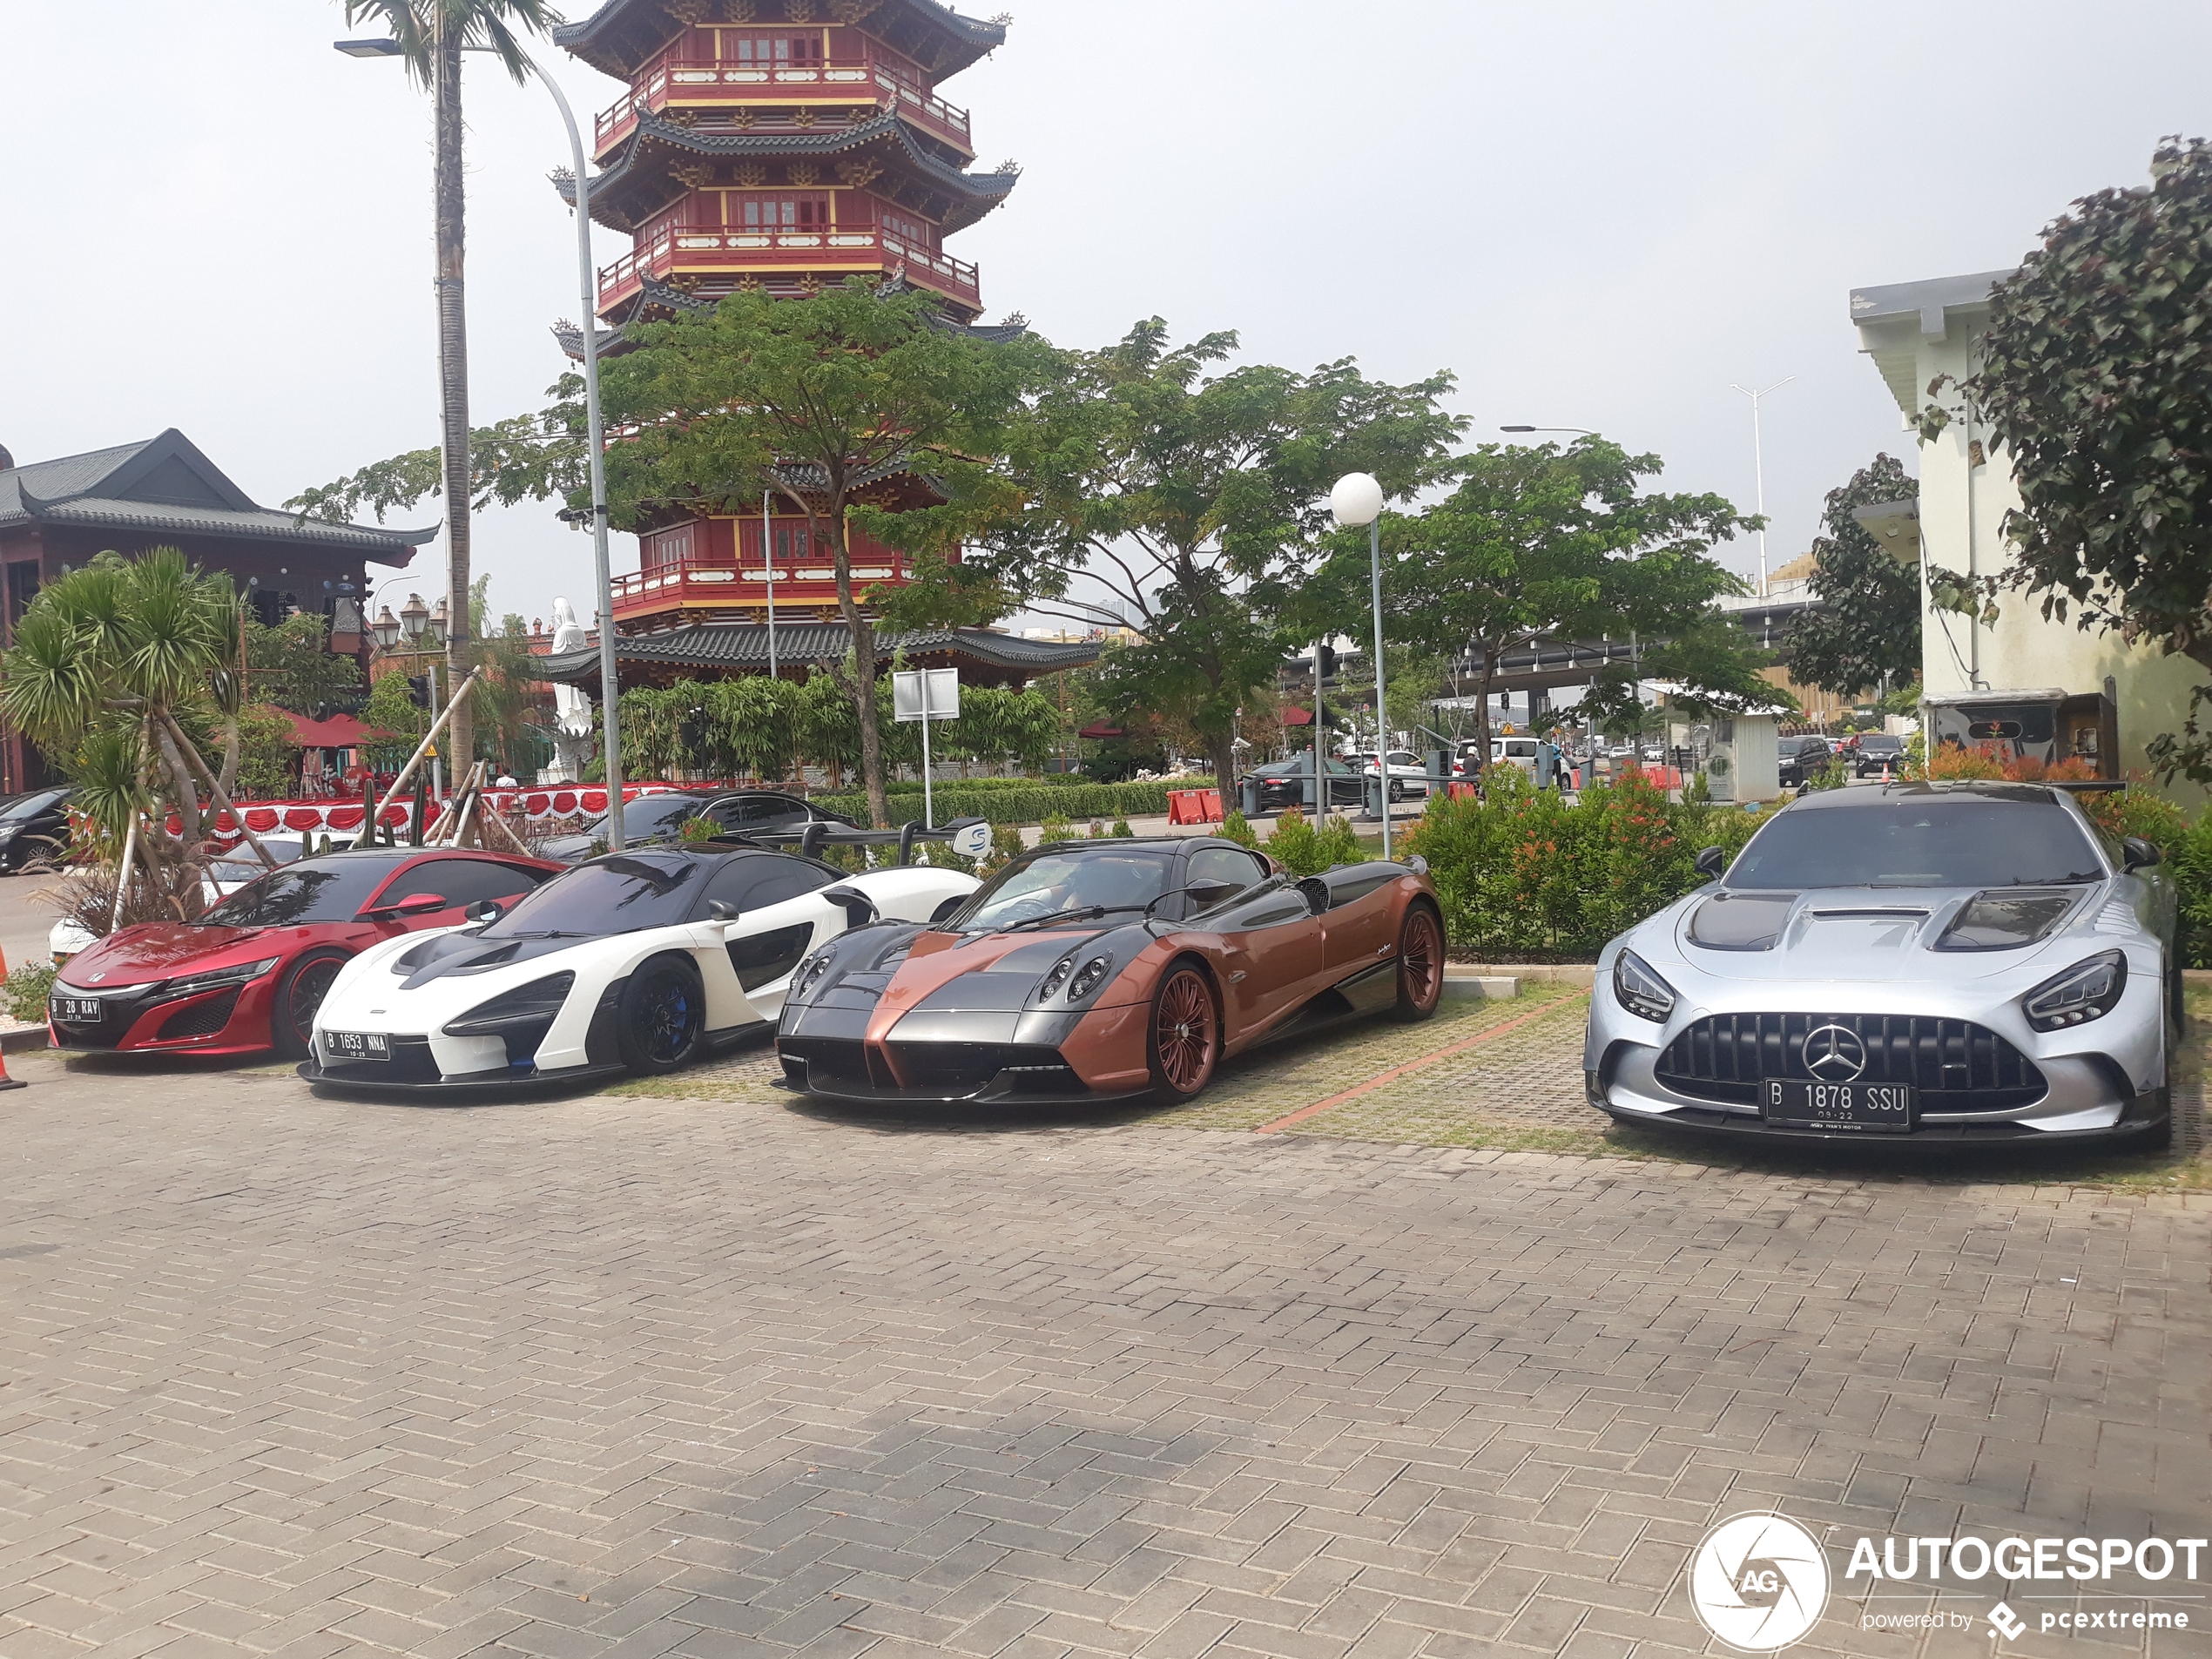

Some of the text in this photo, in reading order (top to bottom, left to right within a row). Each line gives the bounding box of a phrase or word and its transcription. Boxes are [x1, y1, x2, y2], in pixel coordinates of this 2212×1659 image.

[52, 999, 98, 1015] B 28 RAY
[327, 1032, 387, 1051] B 1653 NNA
[1771, 1082, 1905, 1111] B 1878 SSU
